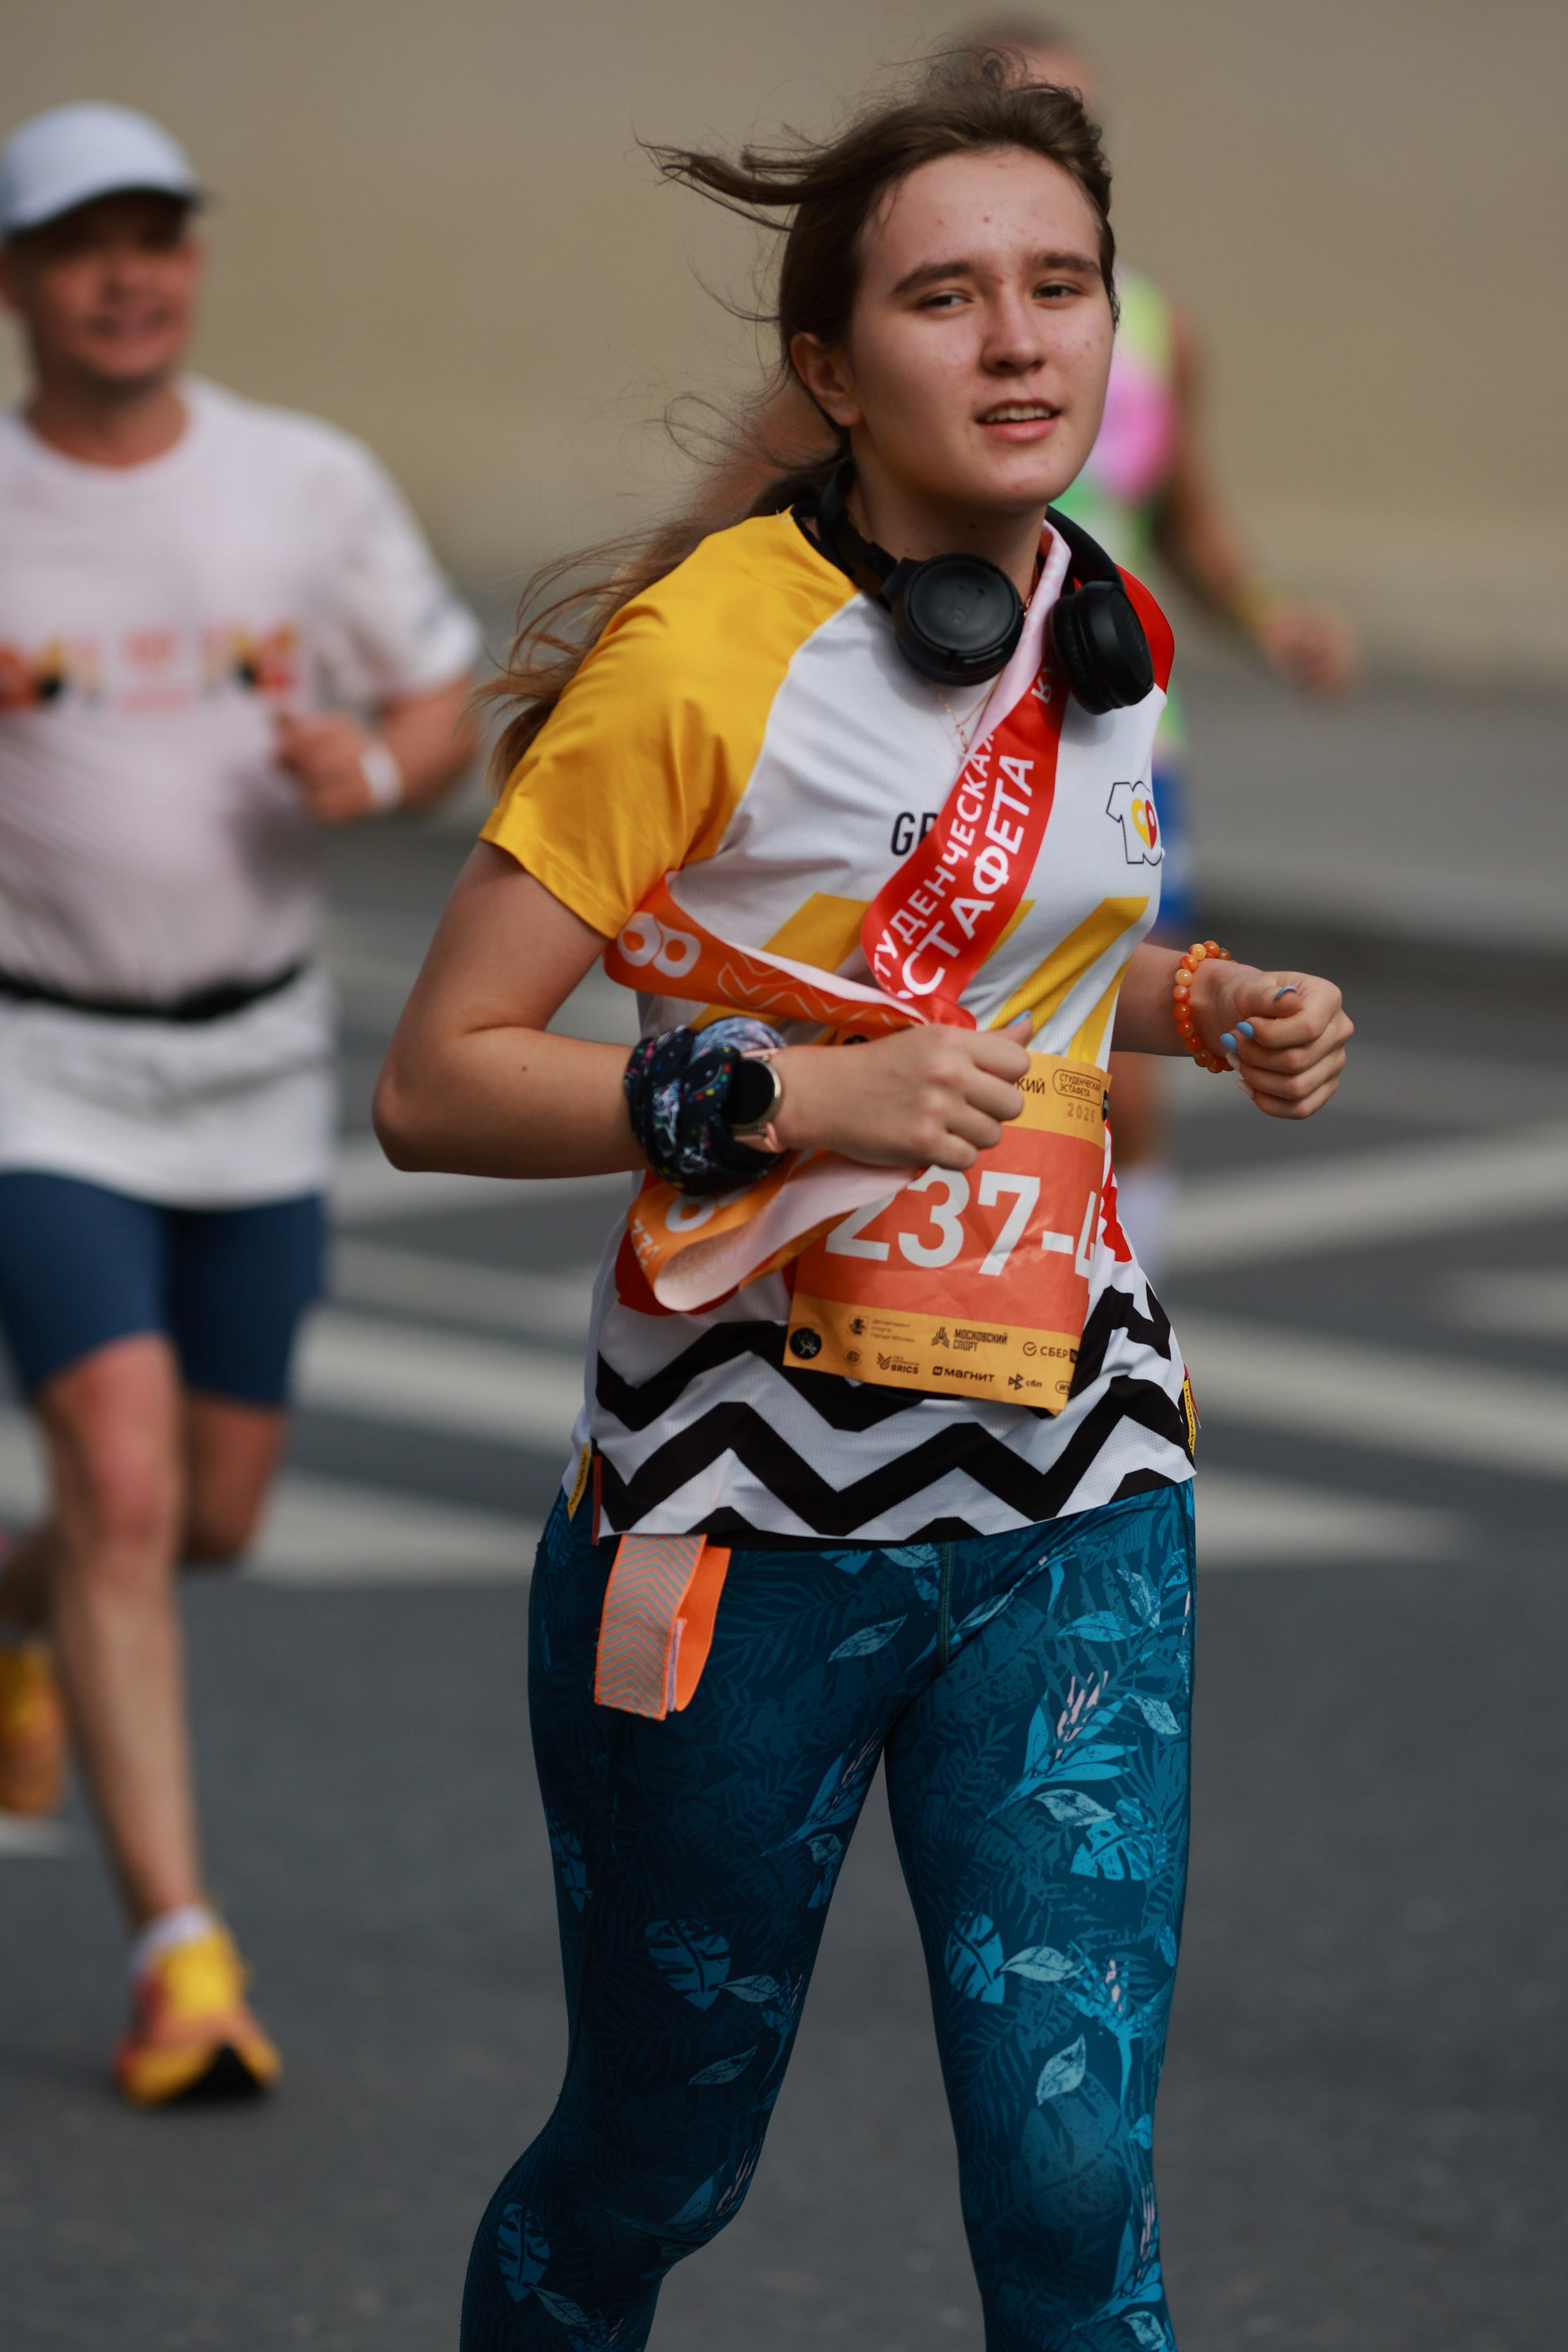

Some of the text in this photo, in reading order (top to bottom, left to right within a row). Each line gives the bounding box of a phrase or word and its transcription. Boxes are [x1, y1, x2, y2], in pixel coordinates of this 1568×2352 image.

[873, 733, 994, 993] ТУДЕНЧЕСКА
[895, 755, 1034, 999] СТАФЕТА
[1059, 1082, 1090, 1098] ЭСТАФЕТА
[1066, 1102, 1096, 1123] 2026
[954, 1327, 1008, 1345] МОСКОВСКИЙ
[952, 1339, 978, 1352] СПОРТ
[1040, 1346, 1069, 1359] СБЕР
[891, 1363, 919, 1374] BRICS
[1185, 1388, 1195, 1451] АРАФОН
